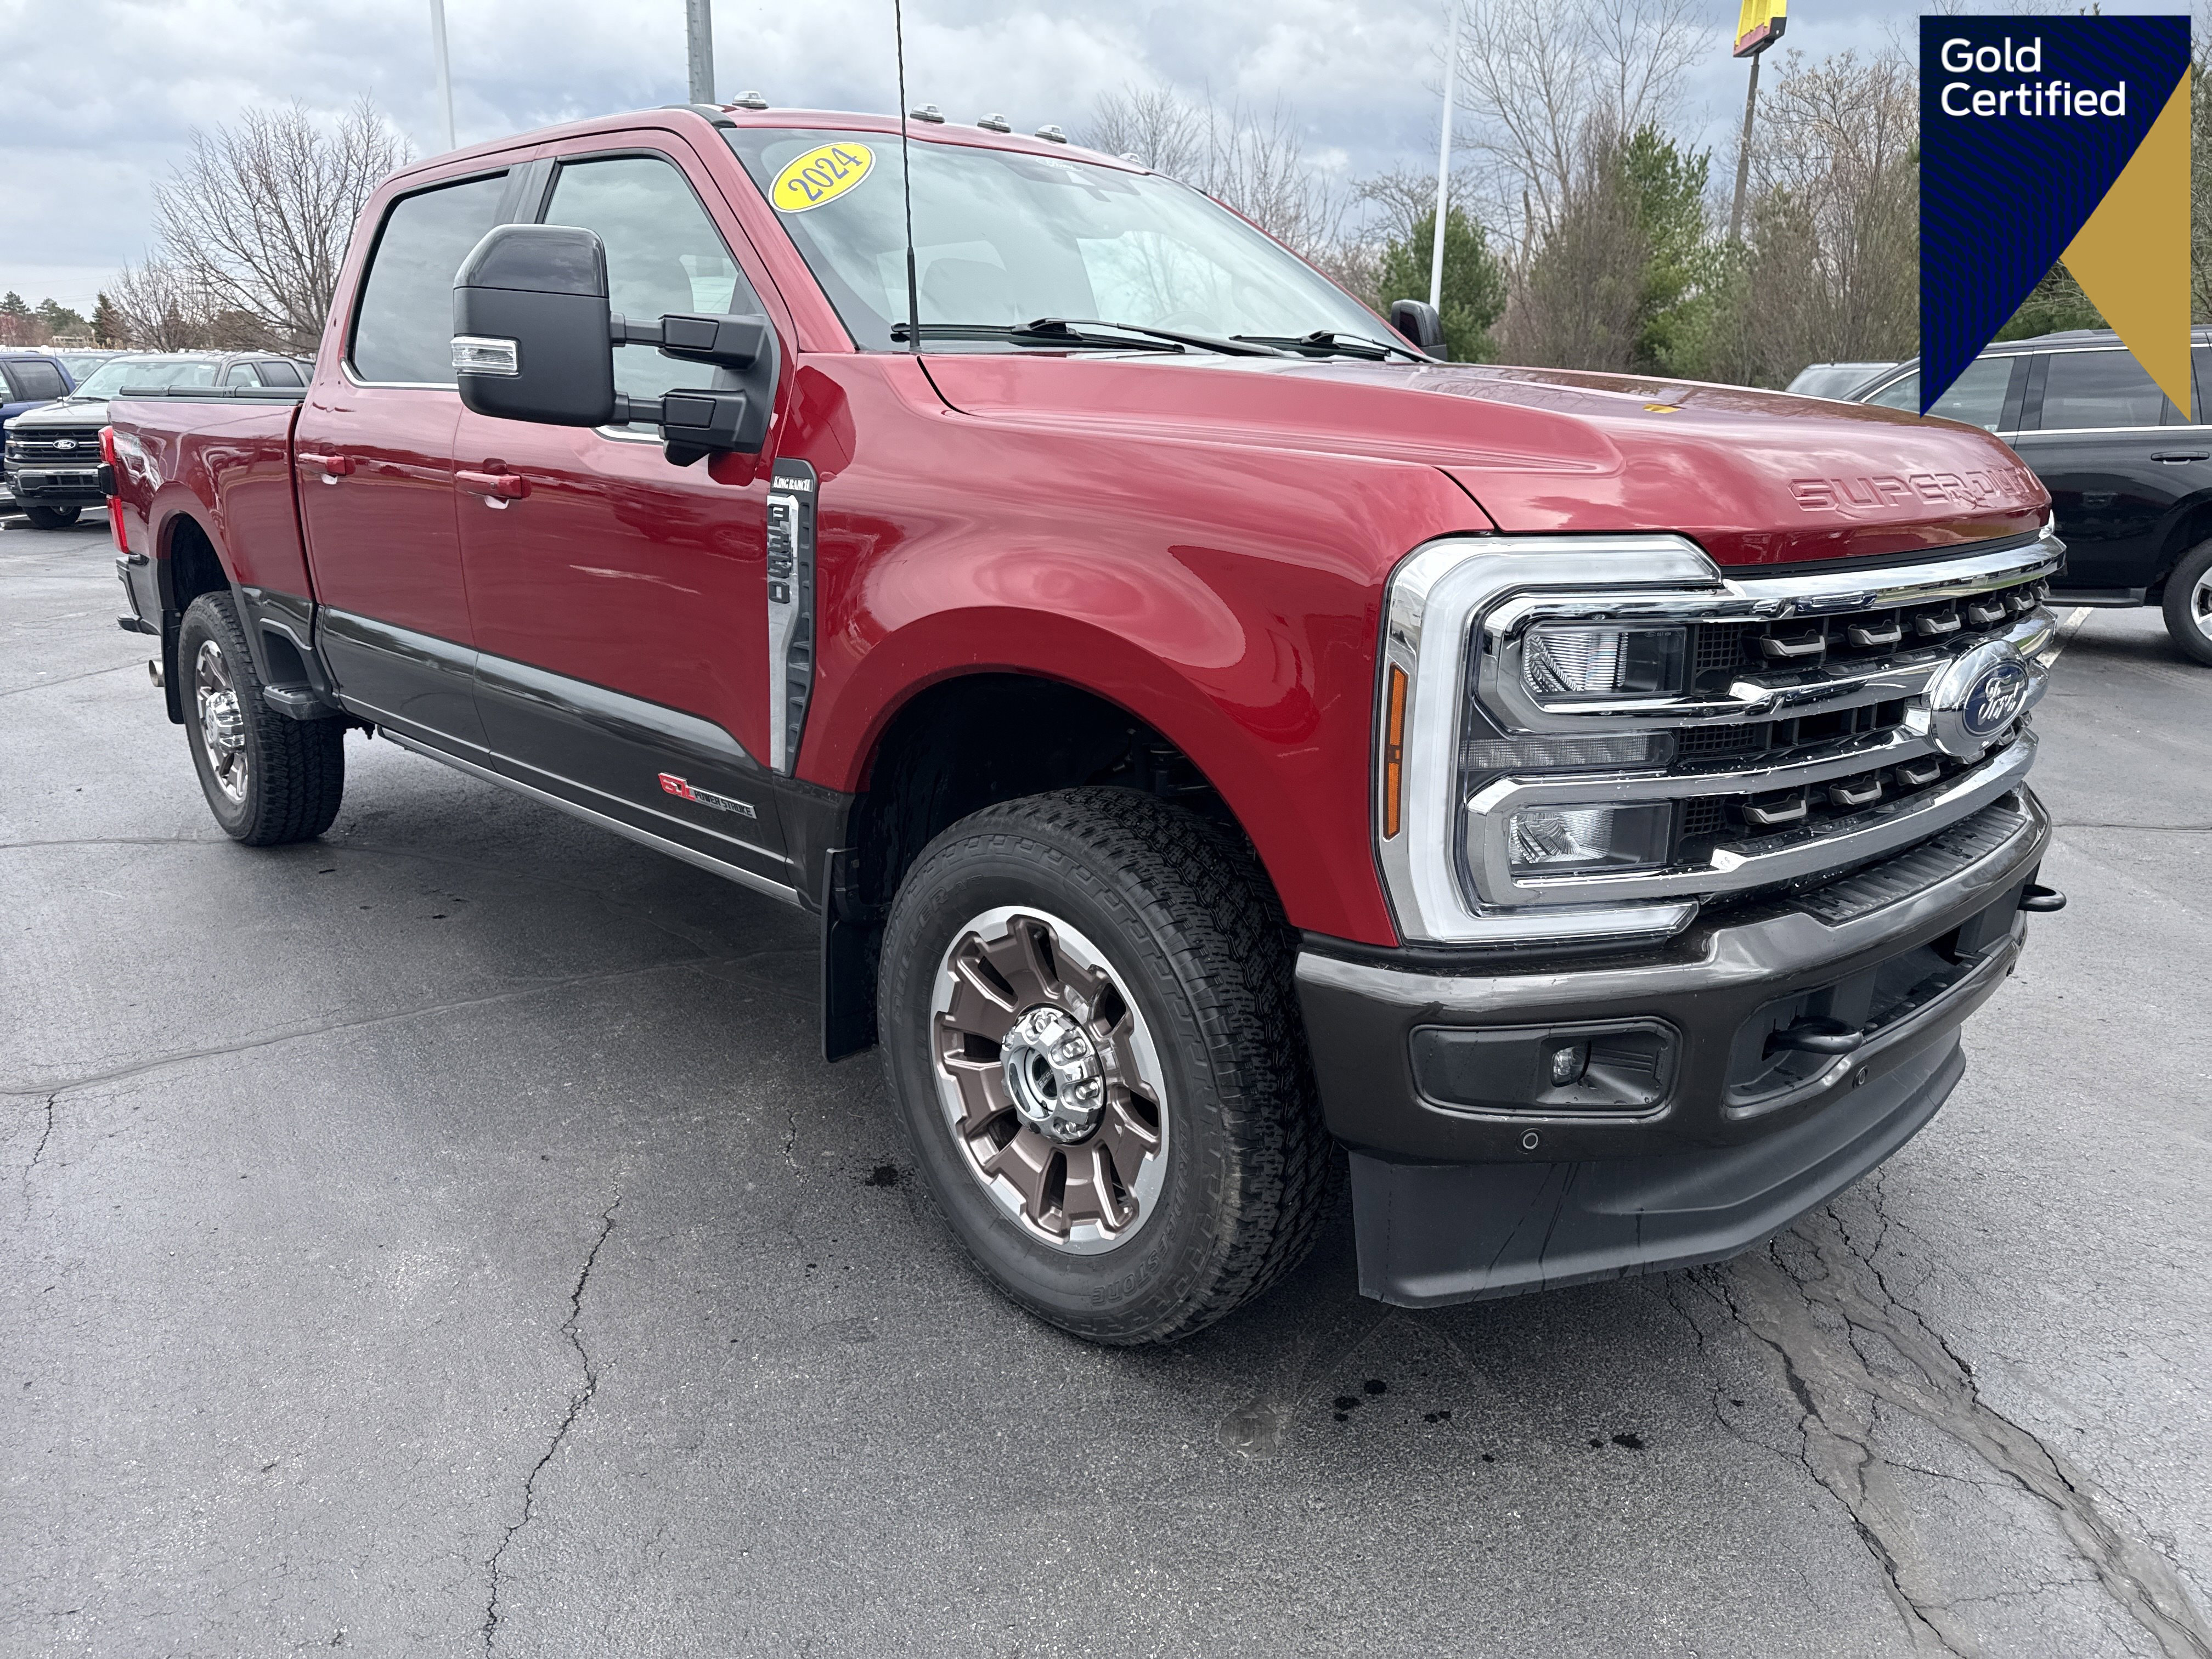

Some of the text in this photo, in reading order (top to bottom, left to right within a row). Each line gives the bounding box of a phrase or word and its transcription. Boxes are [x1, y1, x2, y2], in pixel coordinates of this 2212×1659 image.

[788, 147, 863, 202] 2024
[773, 476, 789, 489] KING
[1787, 473, 1975, 512] SUPER
[1977, 674, 2020, 726] Ford
[693, 790, 721, 806] POWER
[720, 798, 753, 817] STROKE
